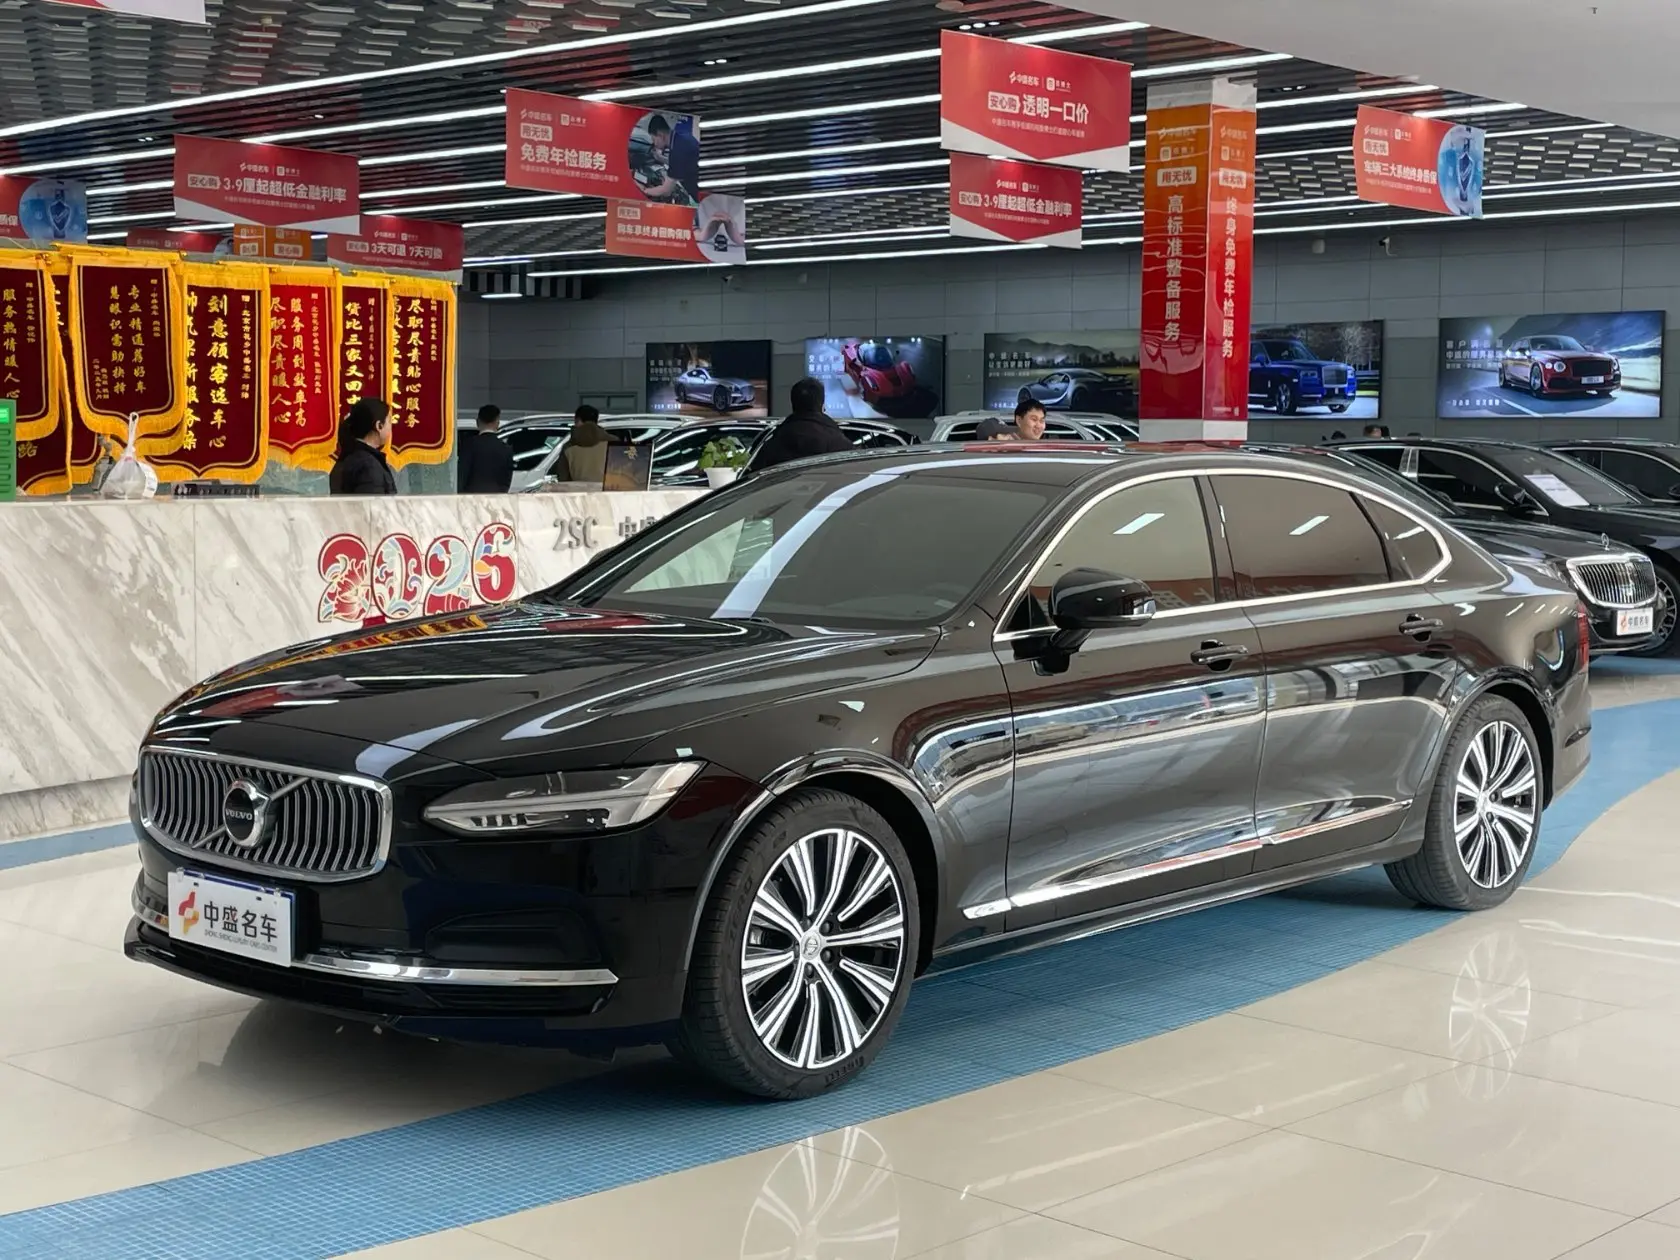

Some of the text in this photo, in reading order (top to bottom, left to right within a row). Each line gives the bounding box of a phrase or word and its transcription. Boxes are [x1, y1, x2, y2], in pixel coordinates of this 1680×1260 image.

[990, 93, 1090, 125] 安心购 透明一口价
[223, 177, 348, 203] 3.9厘起超低金融利率
[520, 142, 607, 171] 免费年检服务
[1162, 169, 1193, 184] 用无忧
[984, 193, 1072, 217] 3.9厘起超低金融利率
[371, 242, 406, 257] 3天可退
[409, 245, 443, 260] 7天可换
[1164, 195, 1184, 342] 高标准整备服务
[1222, 196, 1238, 358] 终身免费年检服务
[3, 288, 20, 399] 服务热情暖人心
[128, 284, 146, 395] 专业精通荐好车
[207, 294, 230, 449] 刻意顾客选车心
[270, 296, 292, 424] 尽职尽责暖人心
[290, 297, 307, 428] 服务周到效率高
[404, 298, 425, 429] 尽职尽责贴心服务
[553, 515, 598, 551] 2SC
[318, 522, 517, 623] 2026
[225, 808, 253, 821] VOLVO
[203, 900, 278, 943] 中盛名车
